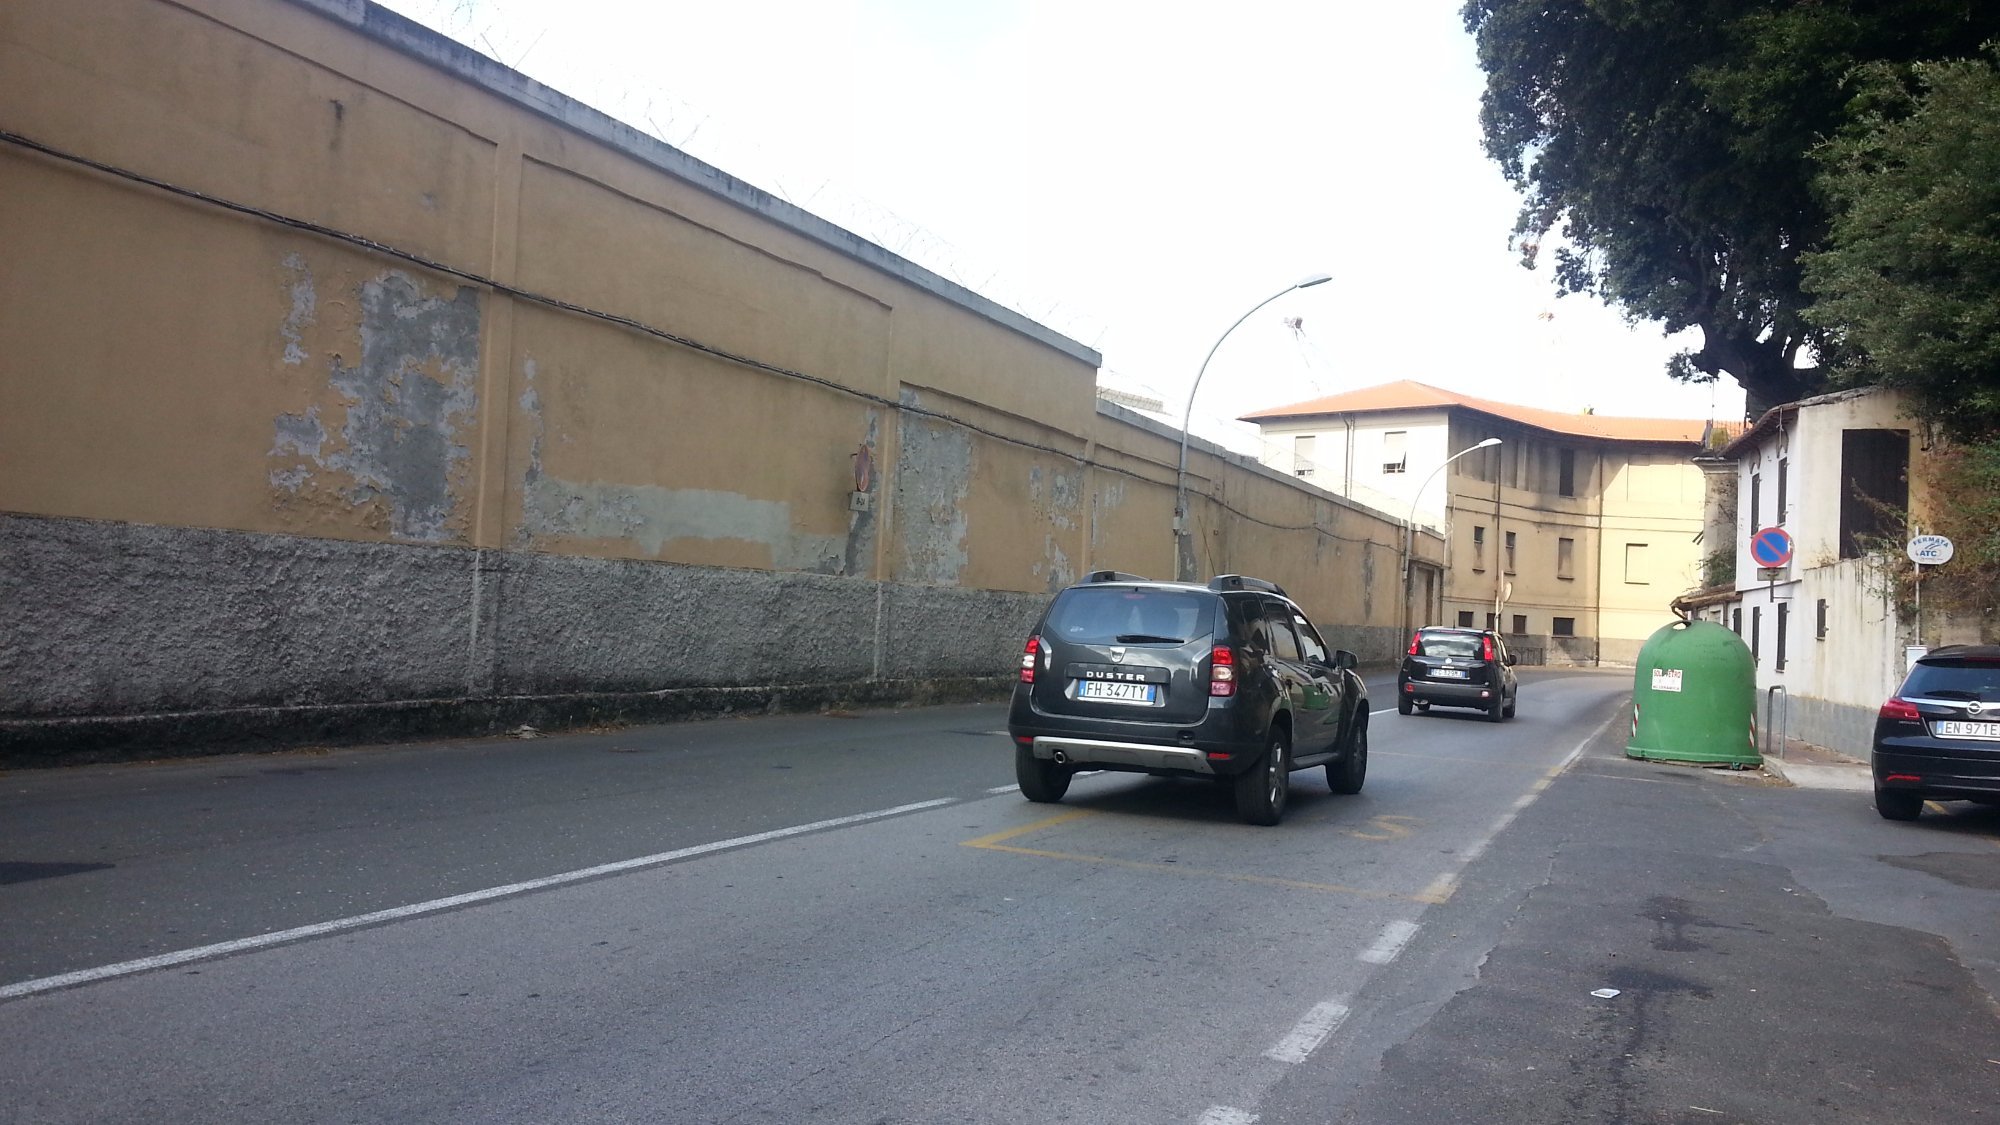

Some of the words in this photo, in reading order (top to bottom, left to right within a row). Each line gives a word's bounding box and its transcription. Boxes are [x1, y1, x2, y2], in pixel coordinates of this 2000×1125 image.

[1912, 537, 1949, 548] FERMATA
[1086, 671, 1145, 682] DUSTER
[1087, 682, 1103, 696] FH
[1106, 683, 1146, 699] 347TY
[1945, 722, 1961, 734] EN
[1966, 723, 2000, 736] 971E
